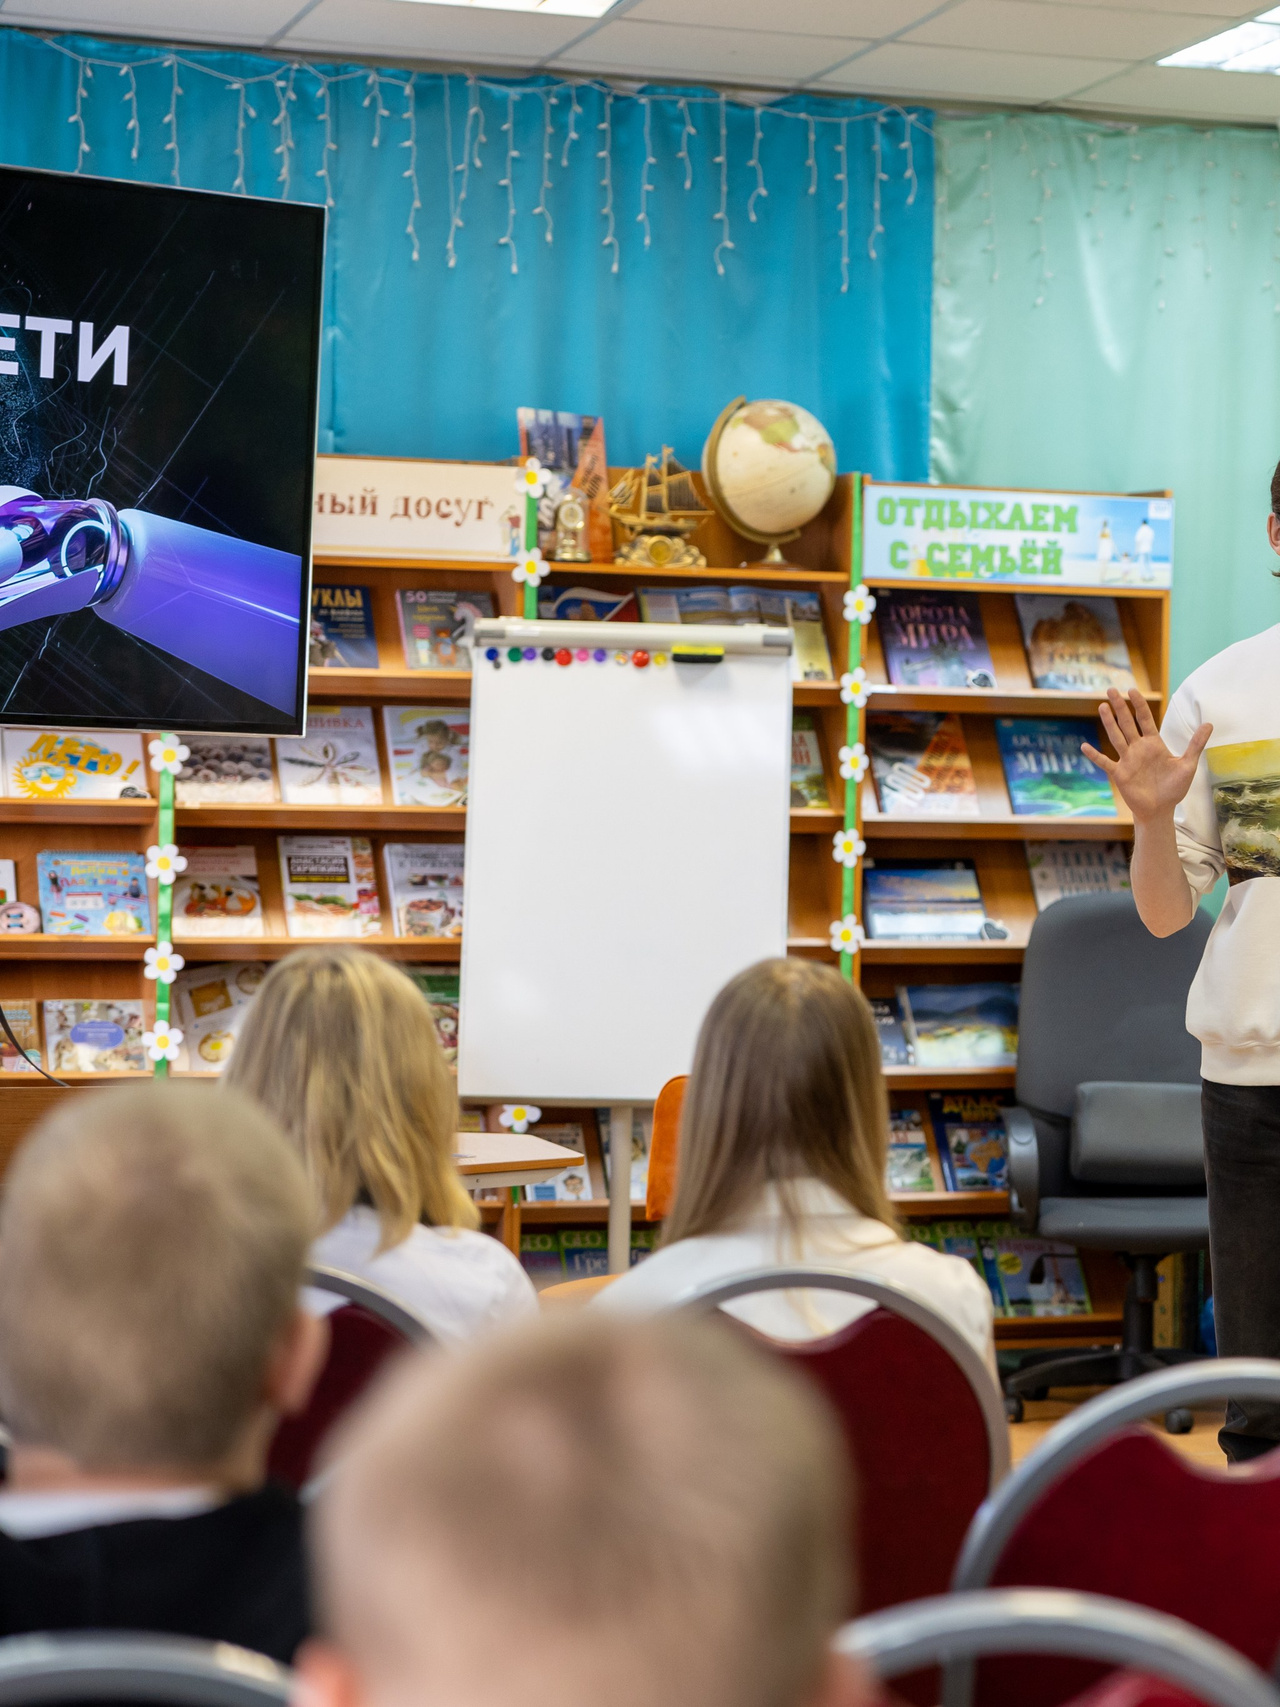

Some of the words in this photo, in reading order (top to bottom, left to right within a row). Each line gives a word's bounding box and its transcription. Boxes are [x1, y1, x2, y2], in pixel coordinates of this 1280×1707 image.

[390, 495, 492, 527] досуг
[877, 497, 1078, 533] ОТДЫХАЕМ
[890, 541, 909, 570] С
[926, 539, 1064, 576] СЕМЬЁЙ
[1016, 751, 1096, 774] МИРА
